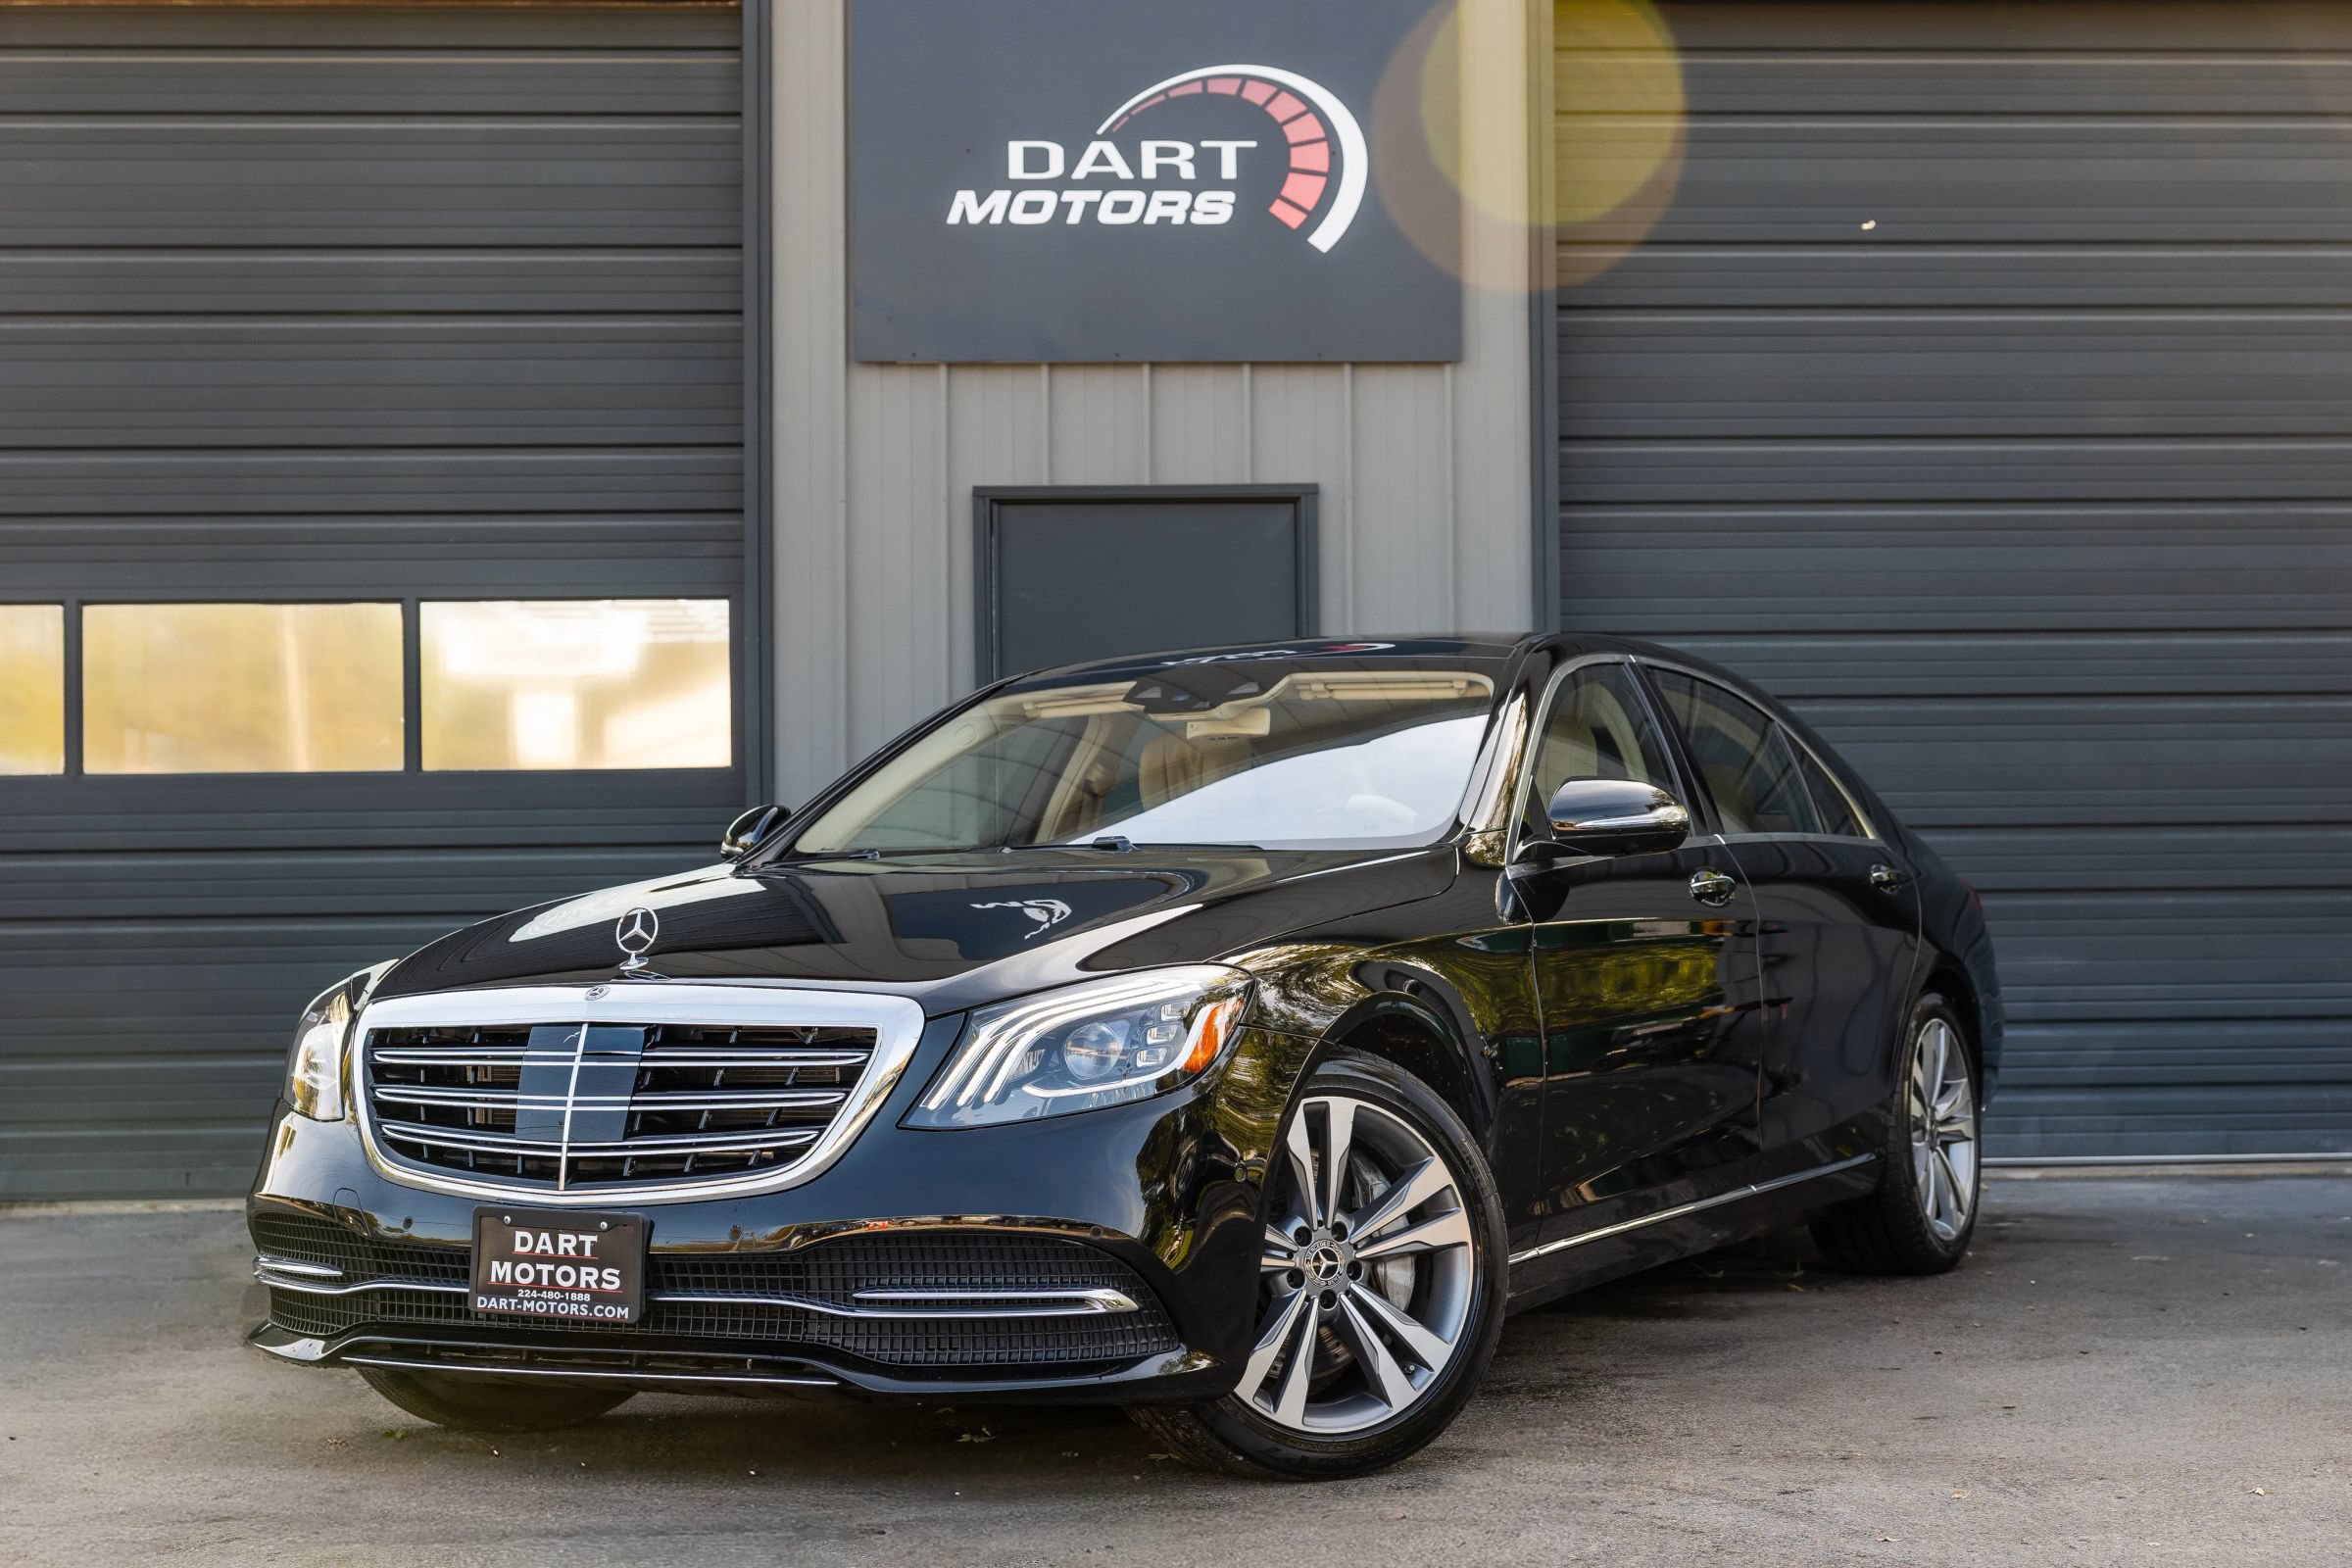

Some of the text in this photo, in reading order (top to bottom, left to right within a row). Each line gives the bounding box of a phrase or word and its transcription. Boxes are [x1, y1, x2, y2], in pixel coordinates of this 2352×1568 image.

[1007, 140, 1257, 180] DART
[946, 189, 1237, 224] MOTORS
[514, 1230, 598, 1257] DART
[490, 1260, 621, 1291] MOTORS
[476, 1296, 629, 1319] DART-MOTORS.COM
[517, 1289, 591, 1301] 224-480-1888
